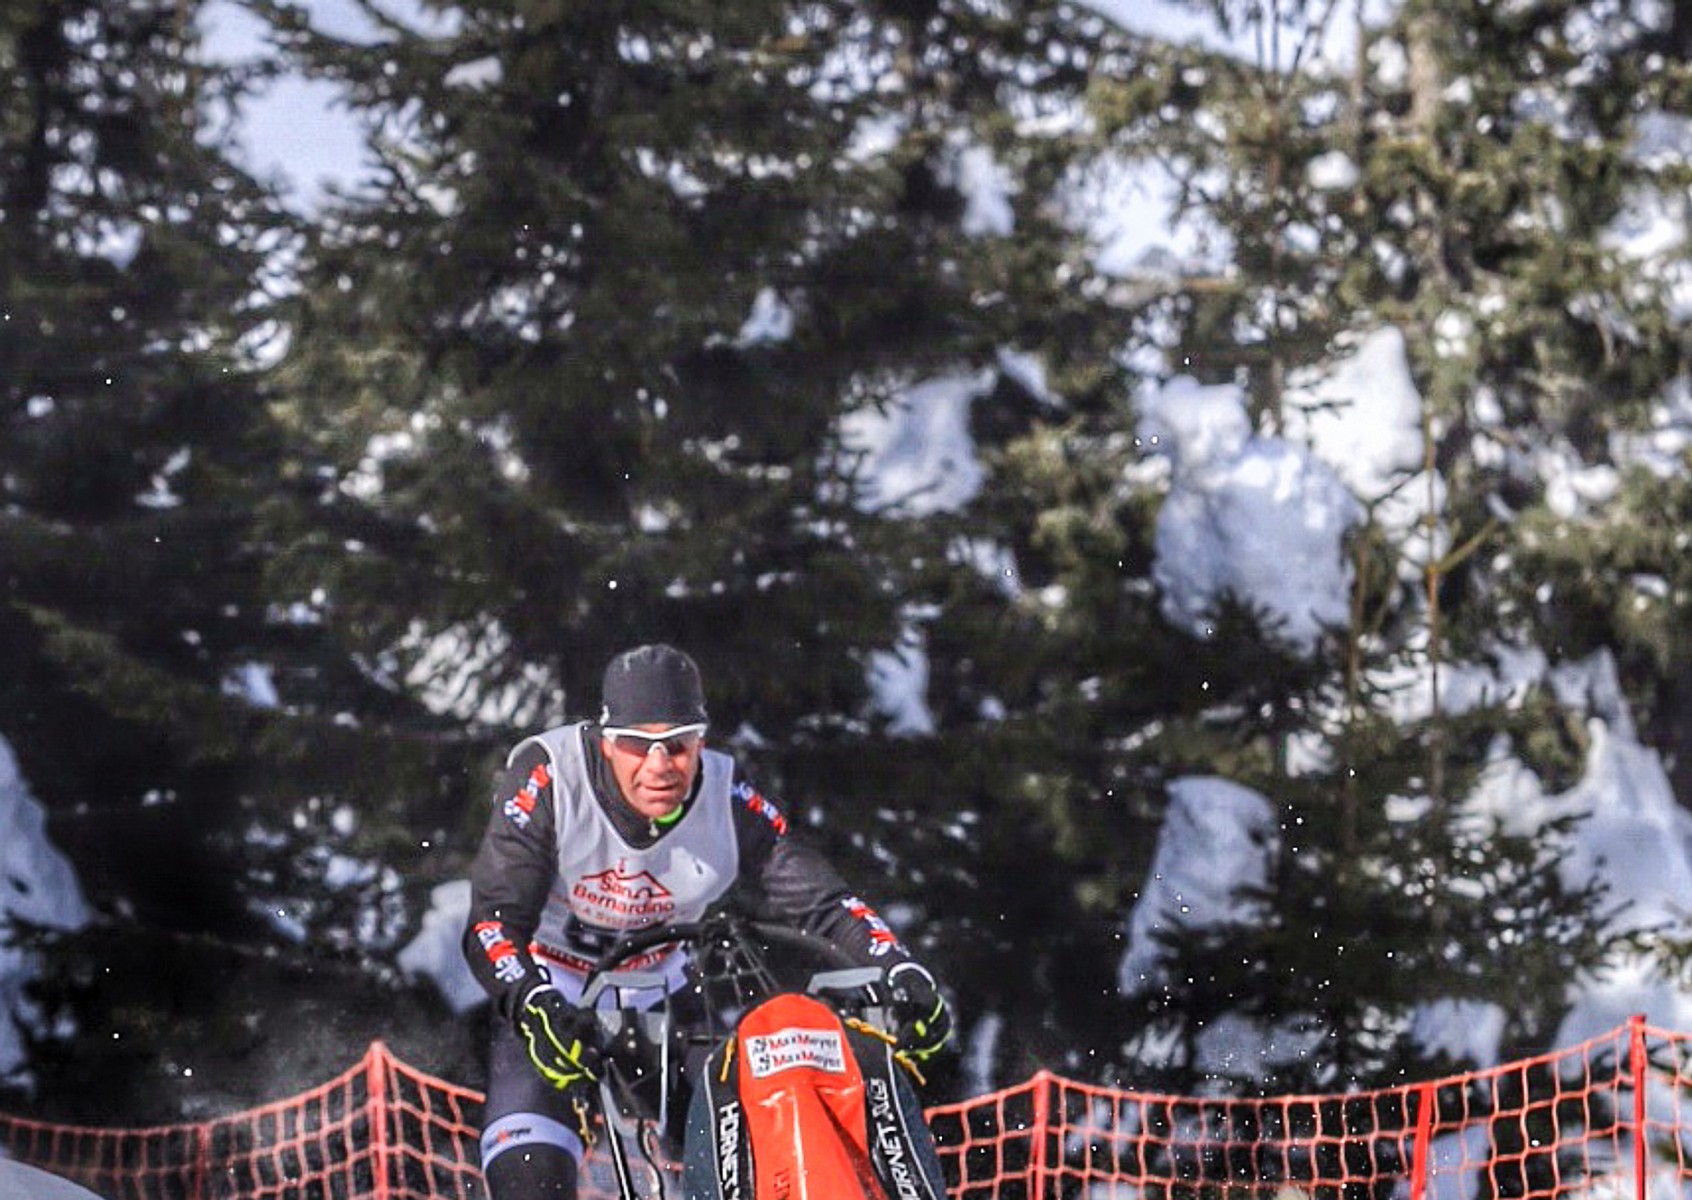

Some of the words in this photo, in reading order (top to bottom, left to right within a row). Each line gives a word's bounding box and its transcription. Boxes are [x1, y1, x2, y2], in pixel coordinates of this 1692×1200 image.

[573, 883, 675, 914] Bernardino
[601, 874, 633, 899] San
[719, 1100, 740, 1190] HORNET
